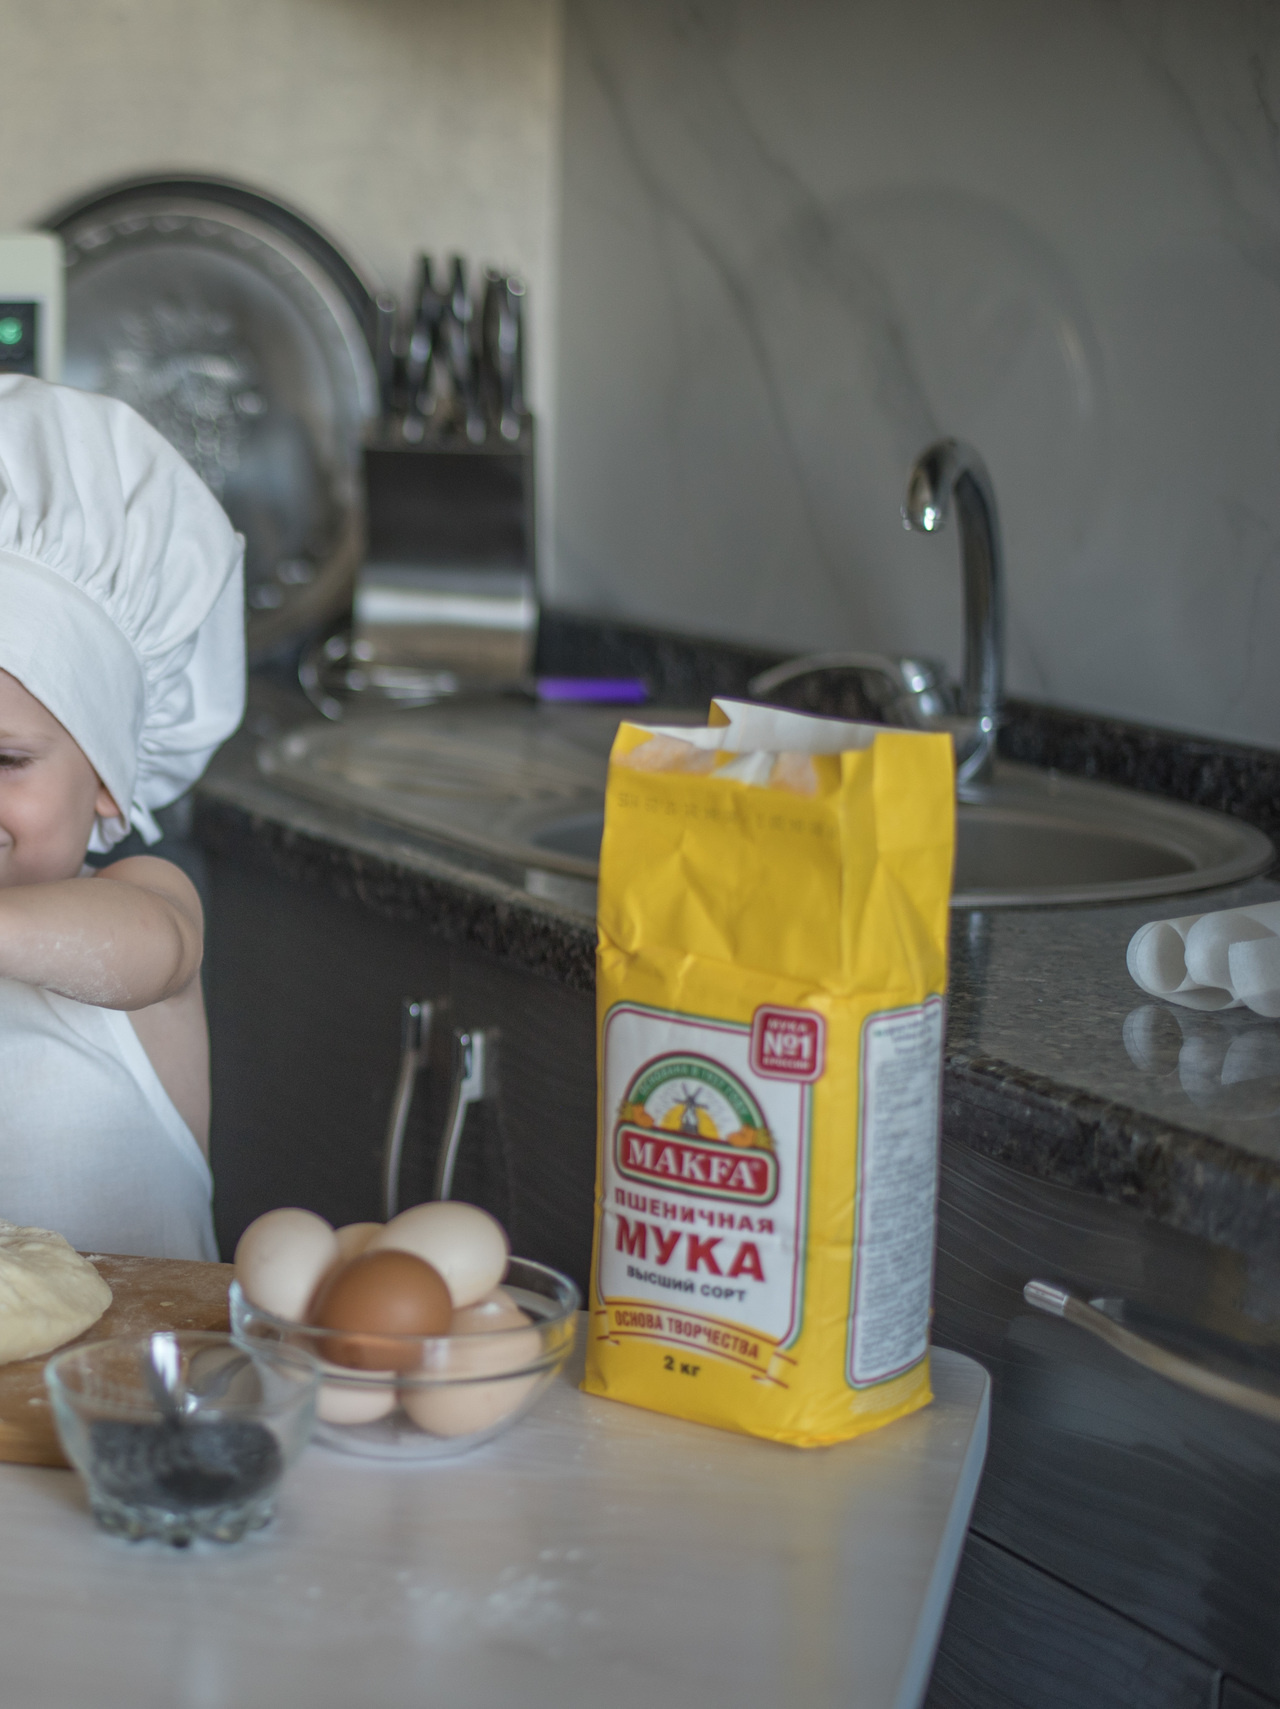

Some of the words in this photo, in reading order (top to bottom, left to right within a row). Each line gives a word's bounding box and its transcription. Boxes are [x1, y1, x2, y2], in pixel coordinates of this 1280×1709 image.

[764, 1031, 810, 1059] №1
[767, 1019, 807, 1032] МУКА
[627, 1138, 756, 1190] MAKFA
[615, 1188, 774, 1234] ПШЕНИЧНАЯ
[615, 1213, 765, 1283] МУКА
[627, 1265, 695, 1294] ВЫСШИЙ
[700, 1284, 746, 1302] СОРТ
[615, 1310, 663, 1331] ОСНОВА
[667, 1317, 759, 1359] ТВОРЧЕСТВА
[663, 1355, 674, 1371] 2
[681, 1362, 701, 1376] кг
